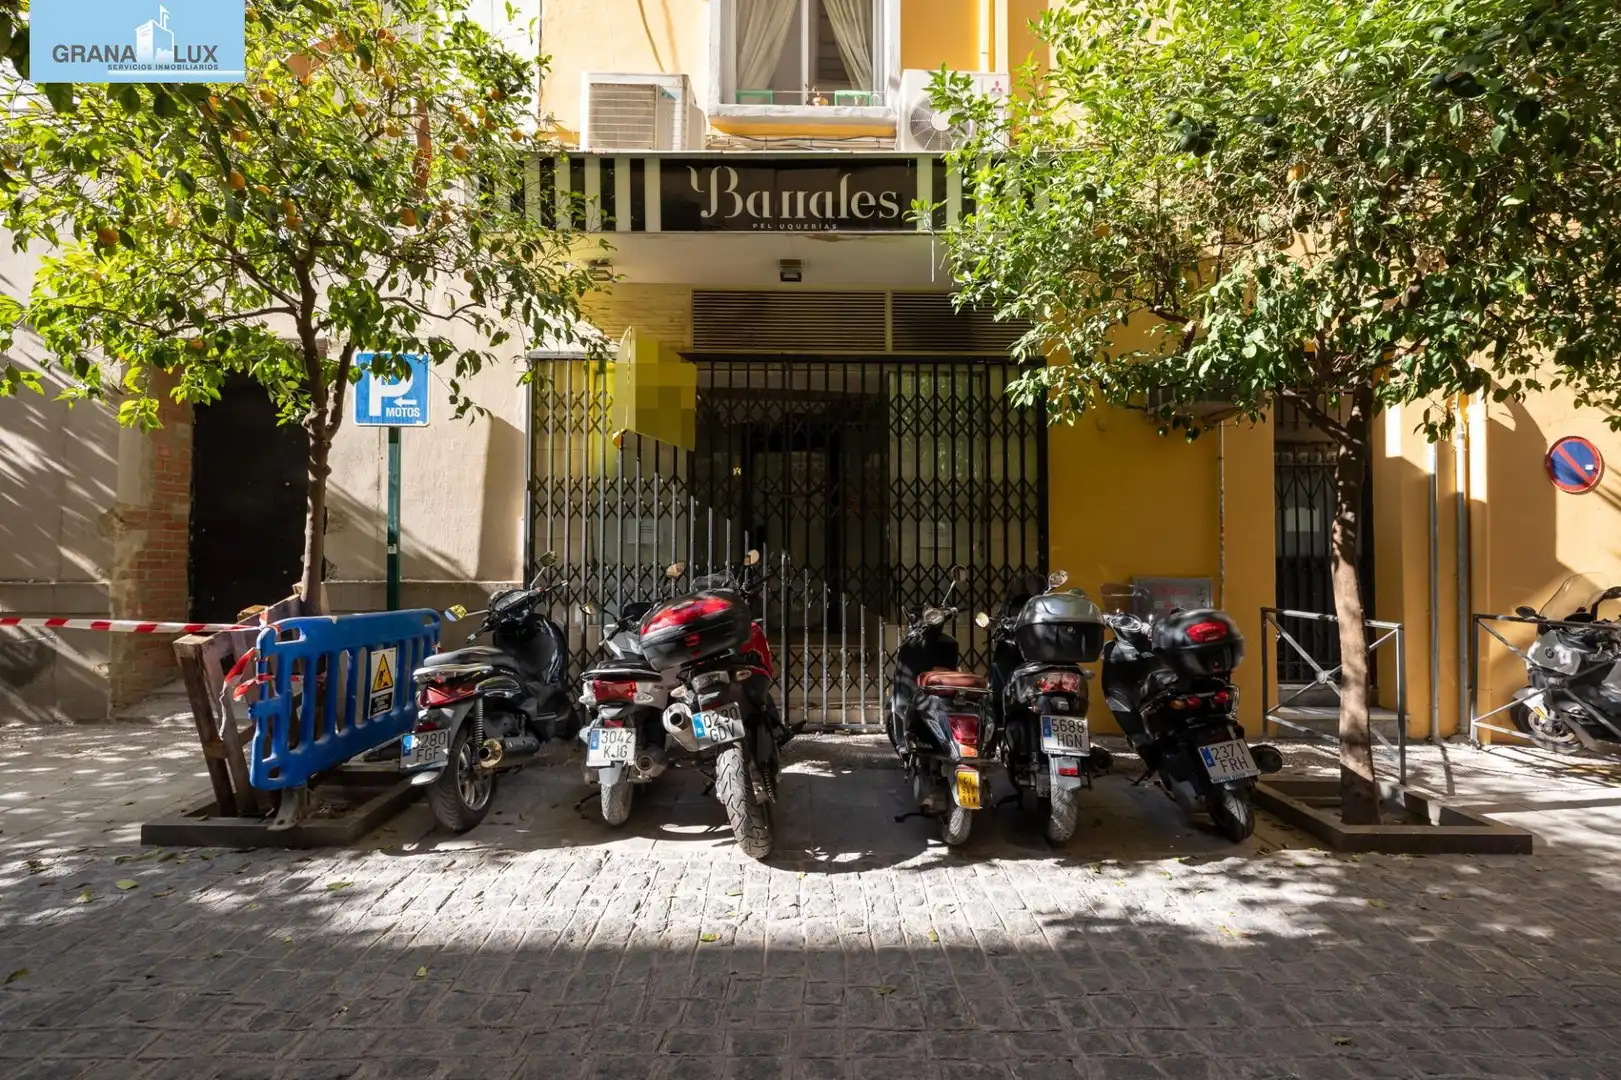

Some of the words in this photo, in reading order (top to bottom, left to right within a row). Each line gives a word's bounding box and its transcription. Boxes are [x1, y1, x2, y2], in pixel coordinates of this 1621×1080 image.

[686, 165, 901, 219] Barrales
[369, 356, 413, 417] P
[385, 407, 420, 417] MOTOS
[710, 722, 735, 743] GDV
[1051, 717, 1085, 733] 5688
[601, 730, 632, 744] 3042
[1057, 735, 1083, 748] HGN
[416, 745, 441, 763] FGF
[603, 744, 628, 758] KJG
[1212, 743, 1245, 761] 2371
[1220, 756, 1249, 773] FRH
